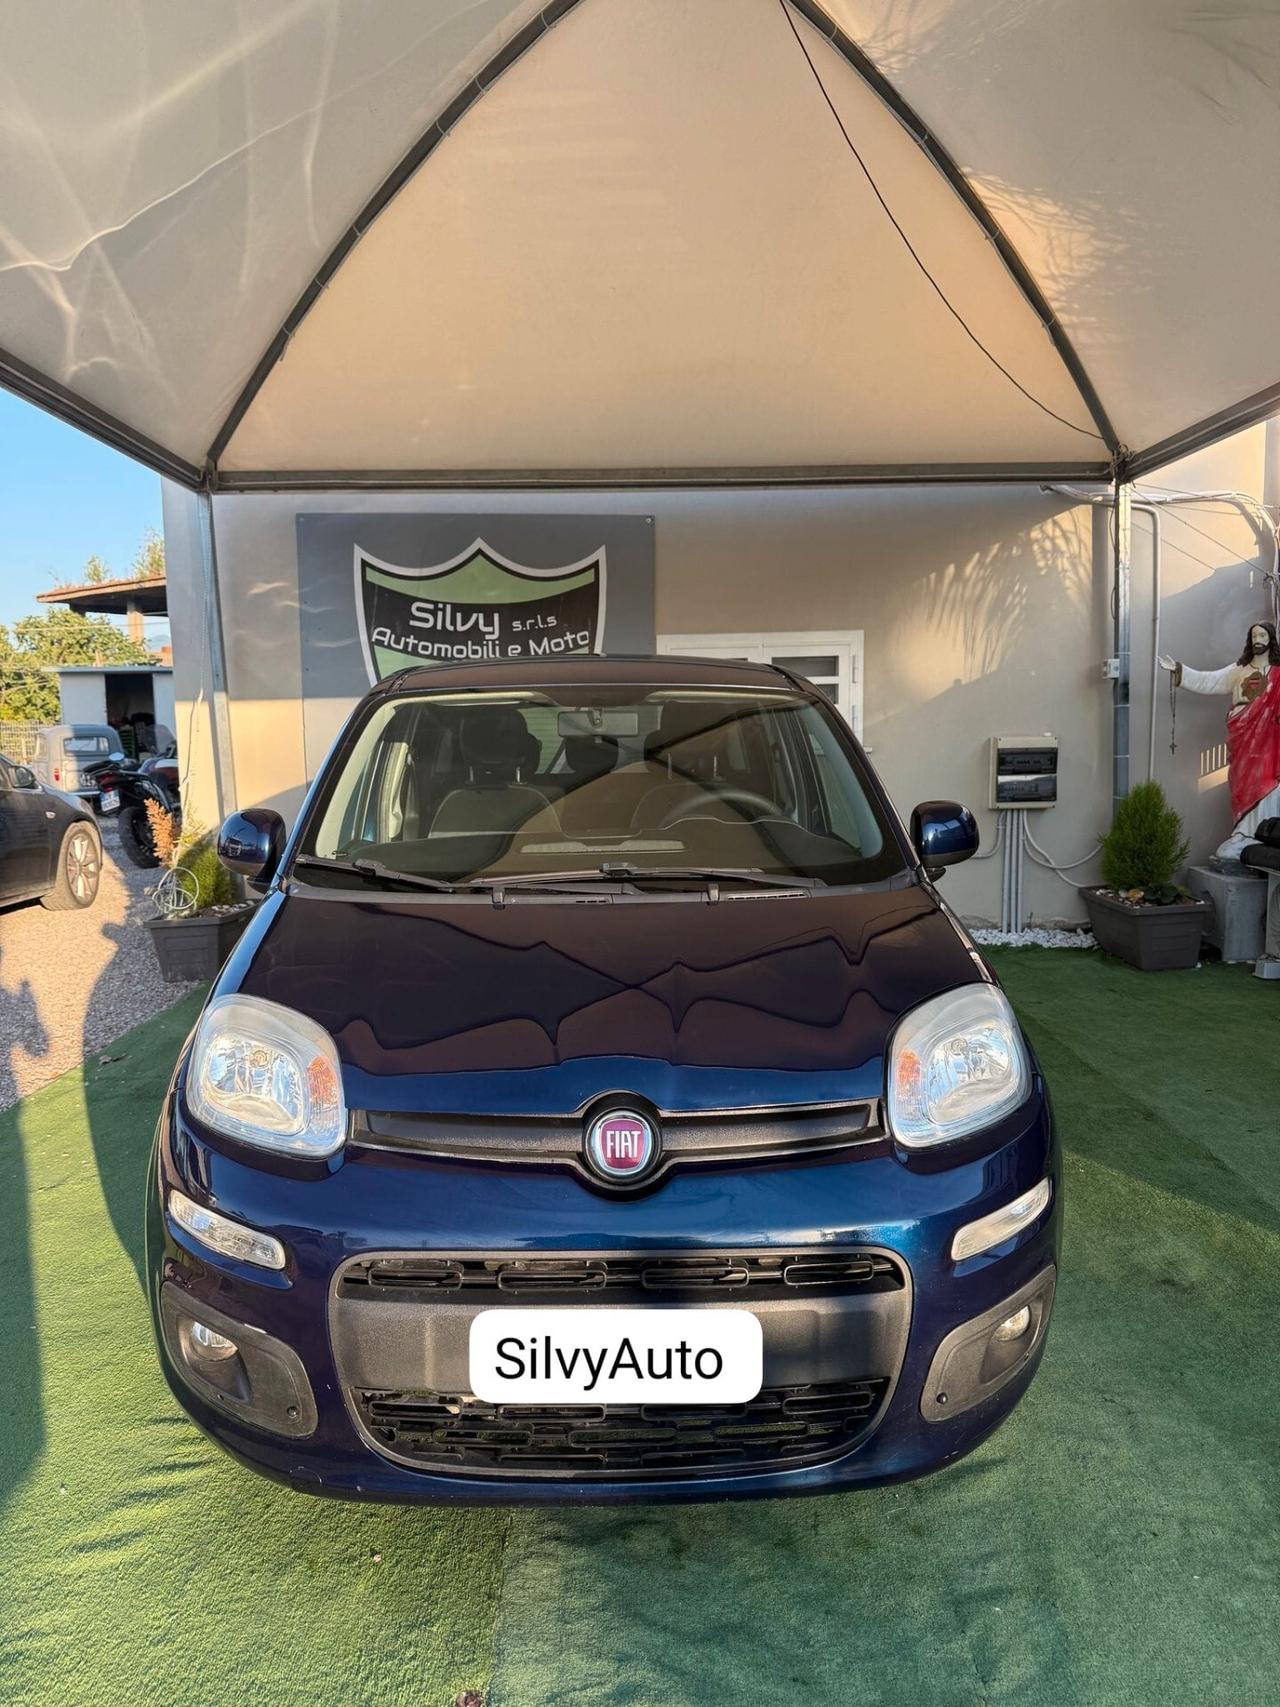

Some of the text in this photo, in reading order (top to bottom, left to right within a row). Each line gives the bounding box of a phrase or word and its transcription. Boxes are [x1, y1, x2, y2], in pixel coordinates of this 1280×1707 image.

[409, 601, 557, 640] Silvy s.r.l.s
[371, 626, 590, 659] Automobili e Moto
[606, 1130, 641, 1158] FIAT
